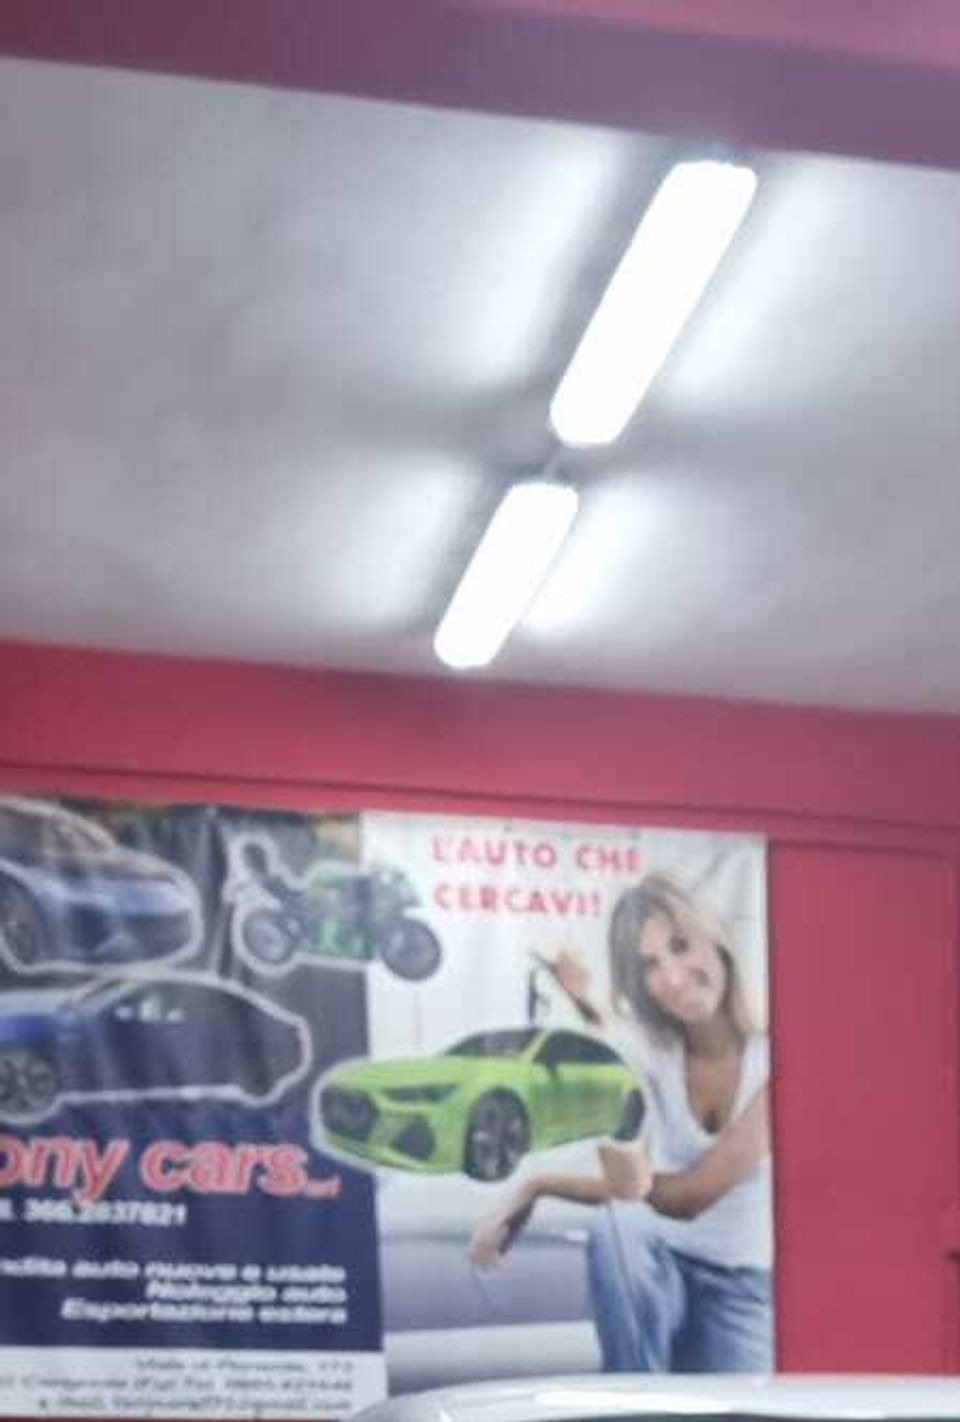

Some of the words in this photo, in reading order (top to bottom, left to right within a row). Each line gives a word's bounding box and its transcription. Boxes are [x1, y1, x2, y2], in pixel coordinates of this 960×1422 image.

[576, 843, 639, 872] CHE
[433, 883, 601, 917] CERCAVI!
[139, 1140, 308, 1197] cars
